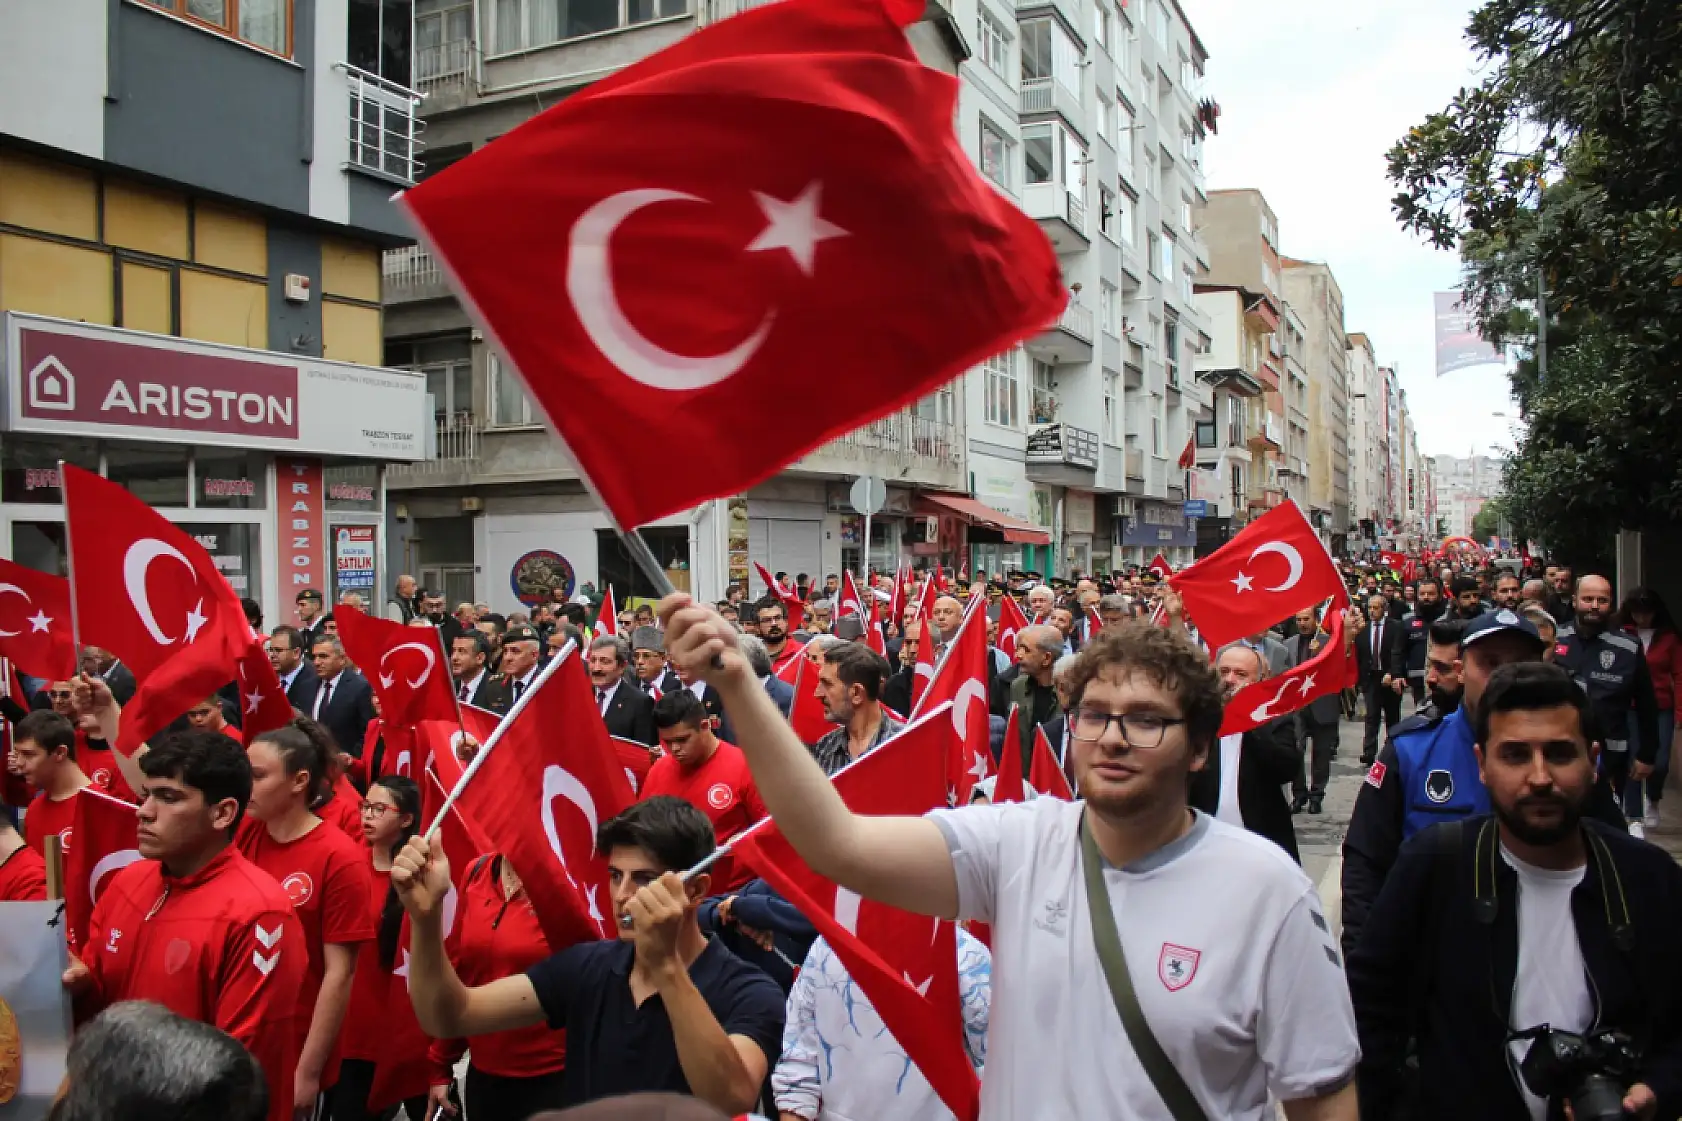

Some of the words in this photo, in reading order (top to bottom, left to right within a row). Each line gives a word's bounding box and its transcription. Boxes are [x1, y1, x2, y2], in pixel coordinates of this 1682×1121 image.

[101, 380, 293, 426] ARISTON
[361, 429, 390, 439] TRABZON
[291, 465, 311, 585] TRABZON
[337, 556, 373, 570] SATILIK
